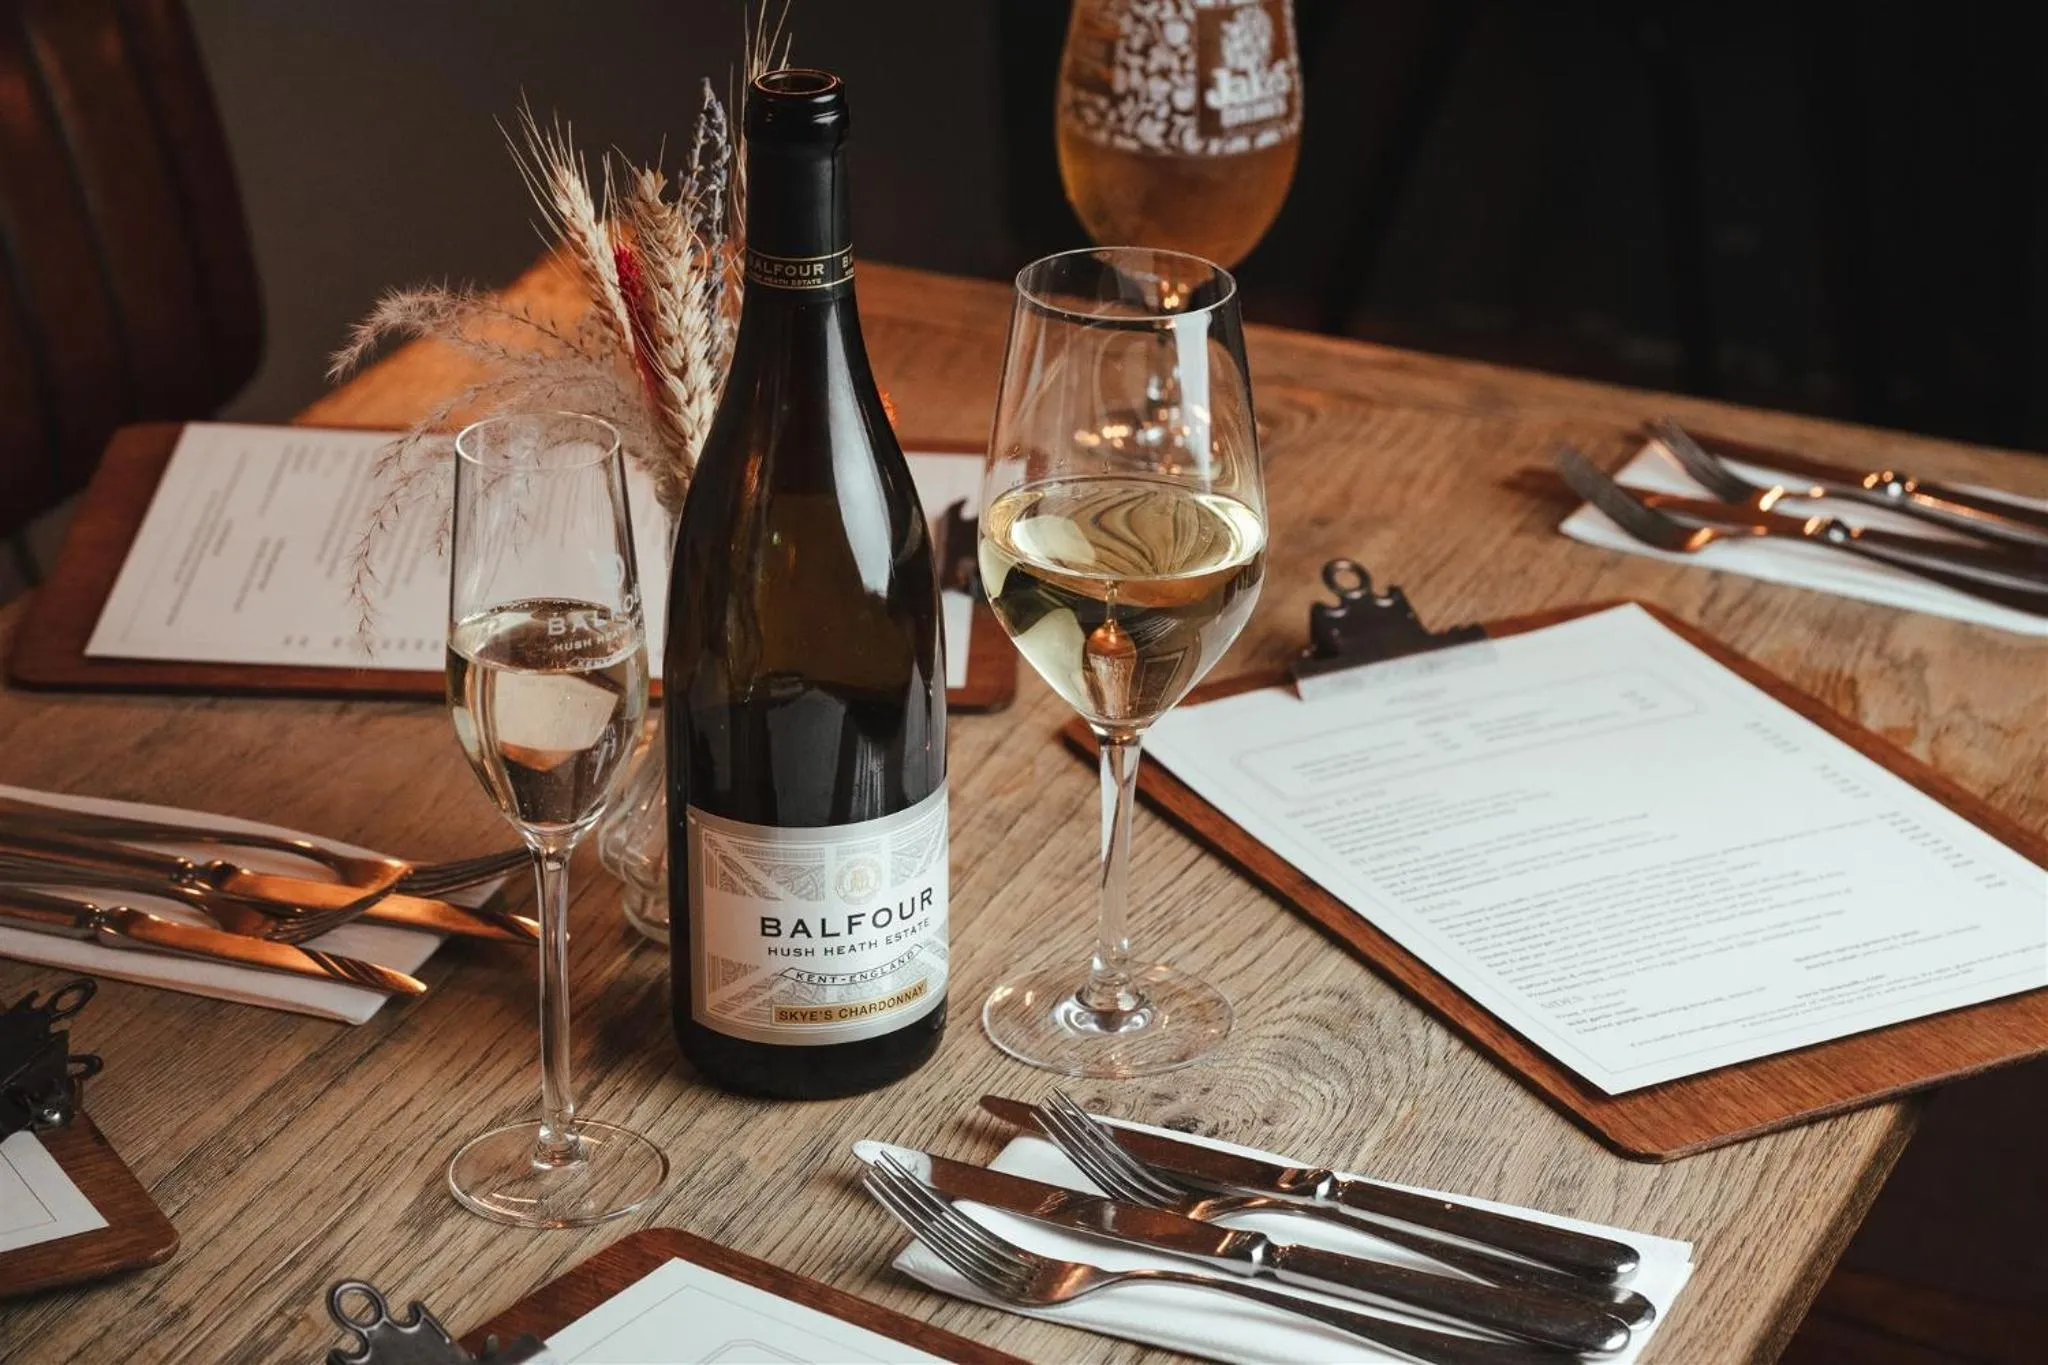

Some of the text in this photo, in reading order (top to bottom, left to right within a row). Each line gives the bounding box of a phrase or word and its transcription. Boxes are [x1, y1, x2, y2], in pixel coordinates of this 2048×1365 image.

[753, 260, 824, 276] ALFOUR
[554, 638, 592, 652] HUSH
[760, 887, 933, 938] BALFOUR
[768, 918, 930, 957] HUSH HEATH ESTATE
[779, 983, 925, 1022] SKYE'S CHARDONNAY
